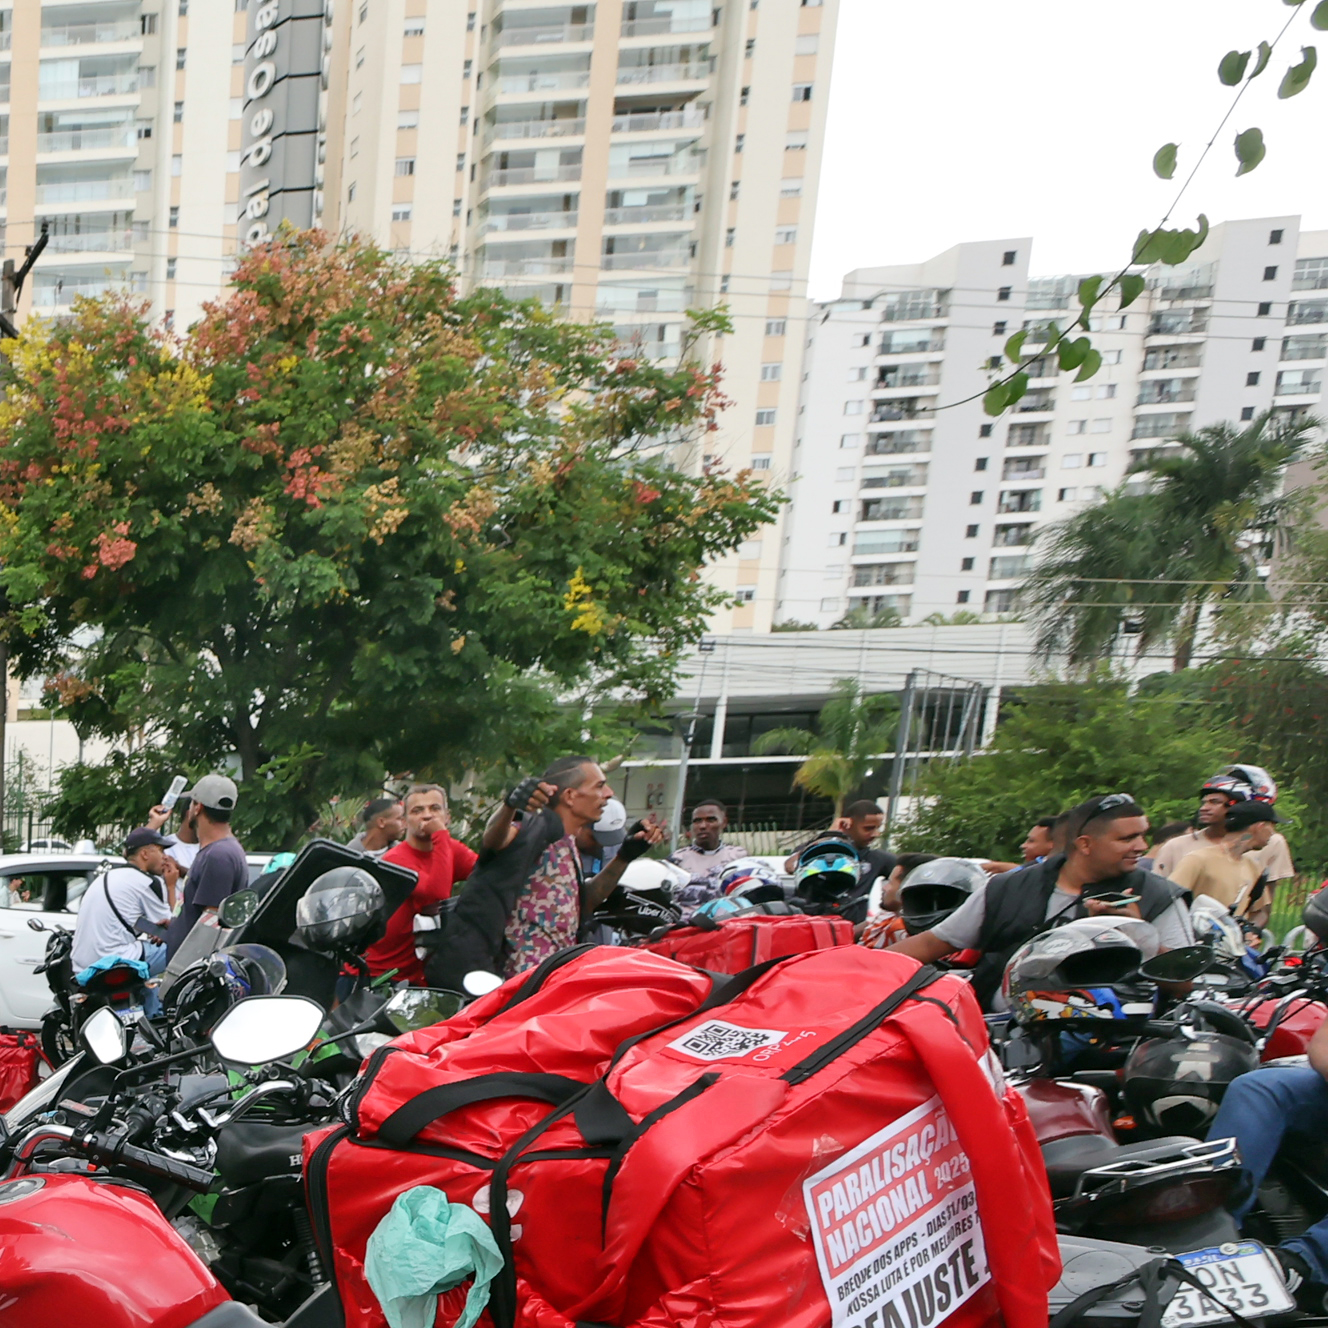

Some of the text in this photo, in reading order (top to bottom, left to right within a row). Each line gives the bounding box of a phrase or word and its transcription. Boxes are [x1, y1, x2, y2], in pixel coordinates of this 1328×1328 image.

[826, 1168, 933, 1270] NACIONAL
[836, 1265, 873, 1303] BREQUE
[873, 1249, 893, 1274] DOS
[894, 1232, 919, 1260] APPS
[926, 1214, 948, 1239] DIAS
[881, 1268, 904, 1294] LUTA
[903, 1258, 911, 1278] É
[910, 1250, 930, 1274] POR
